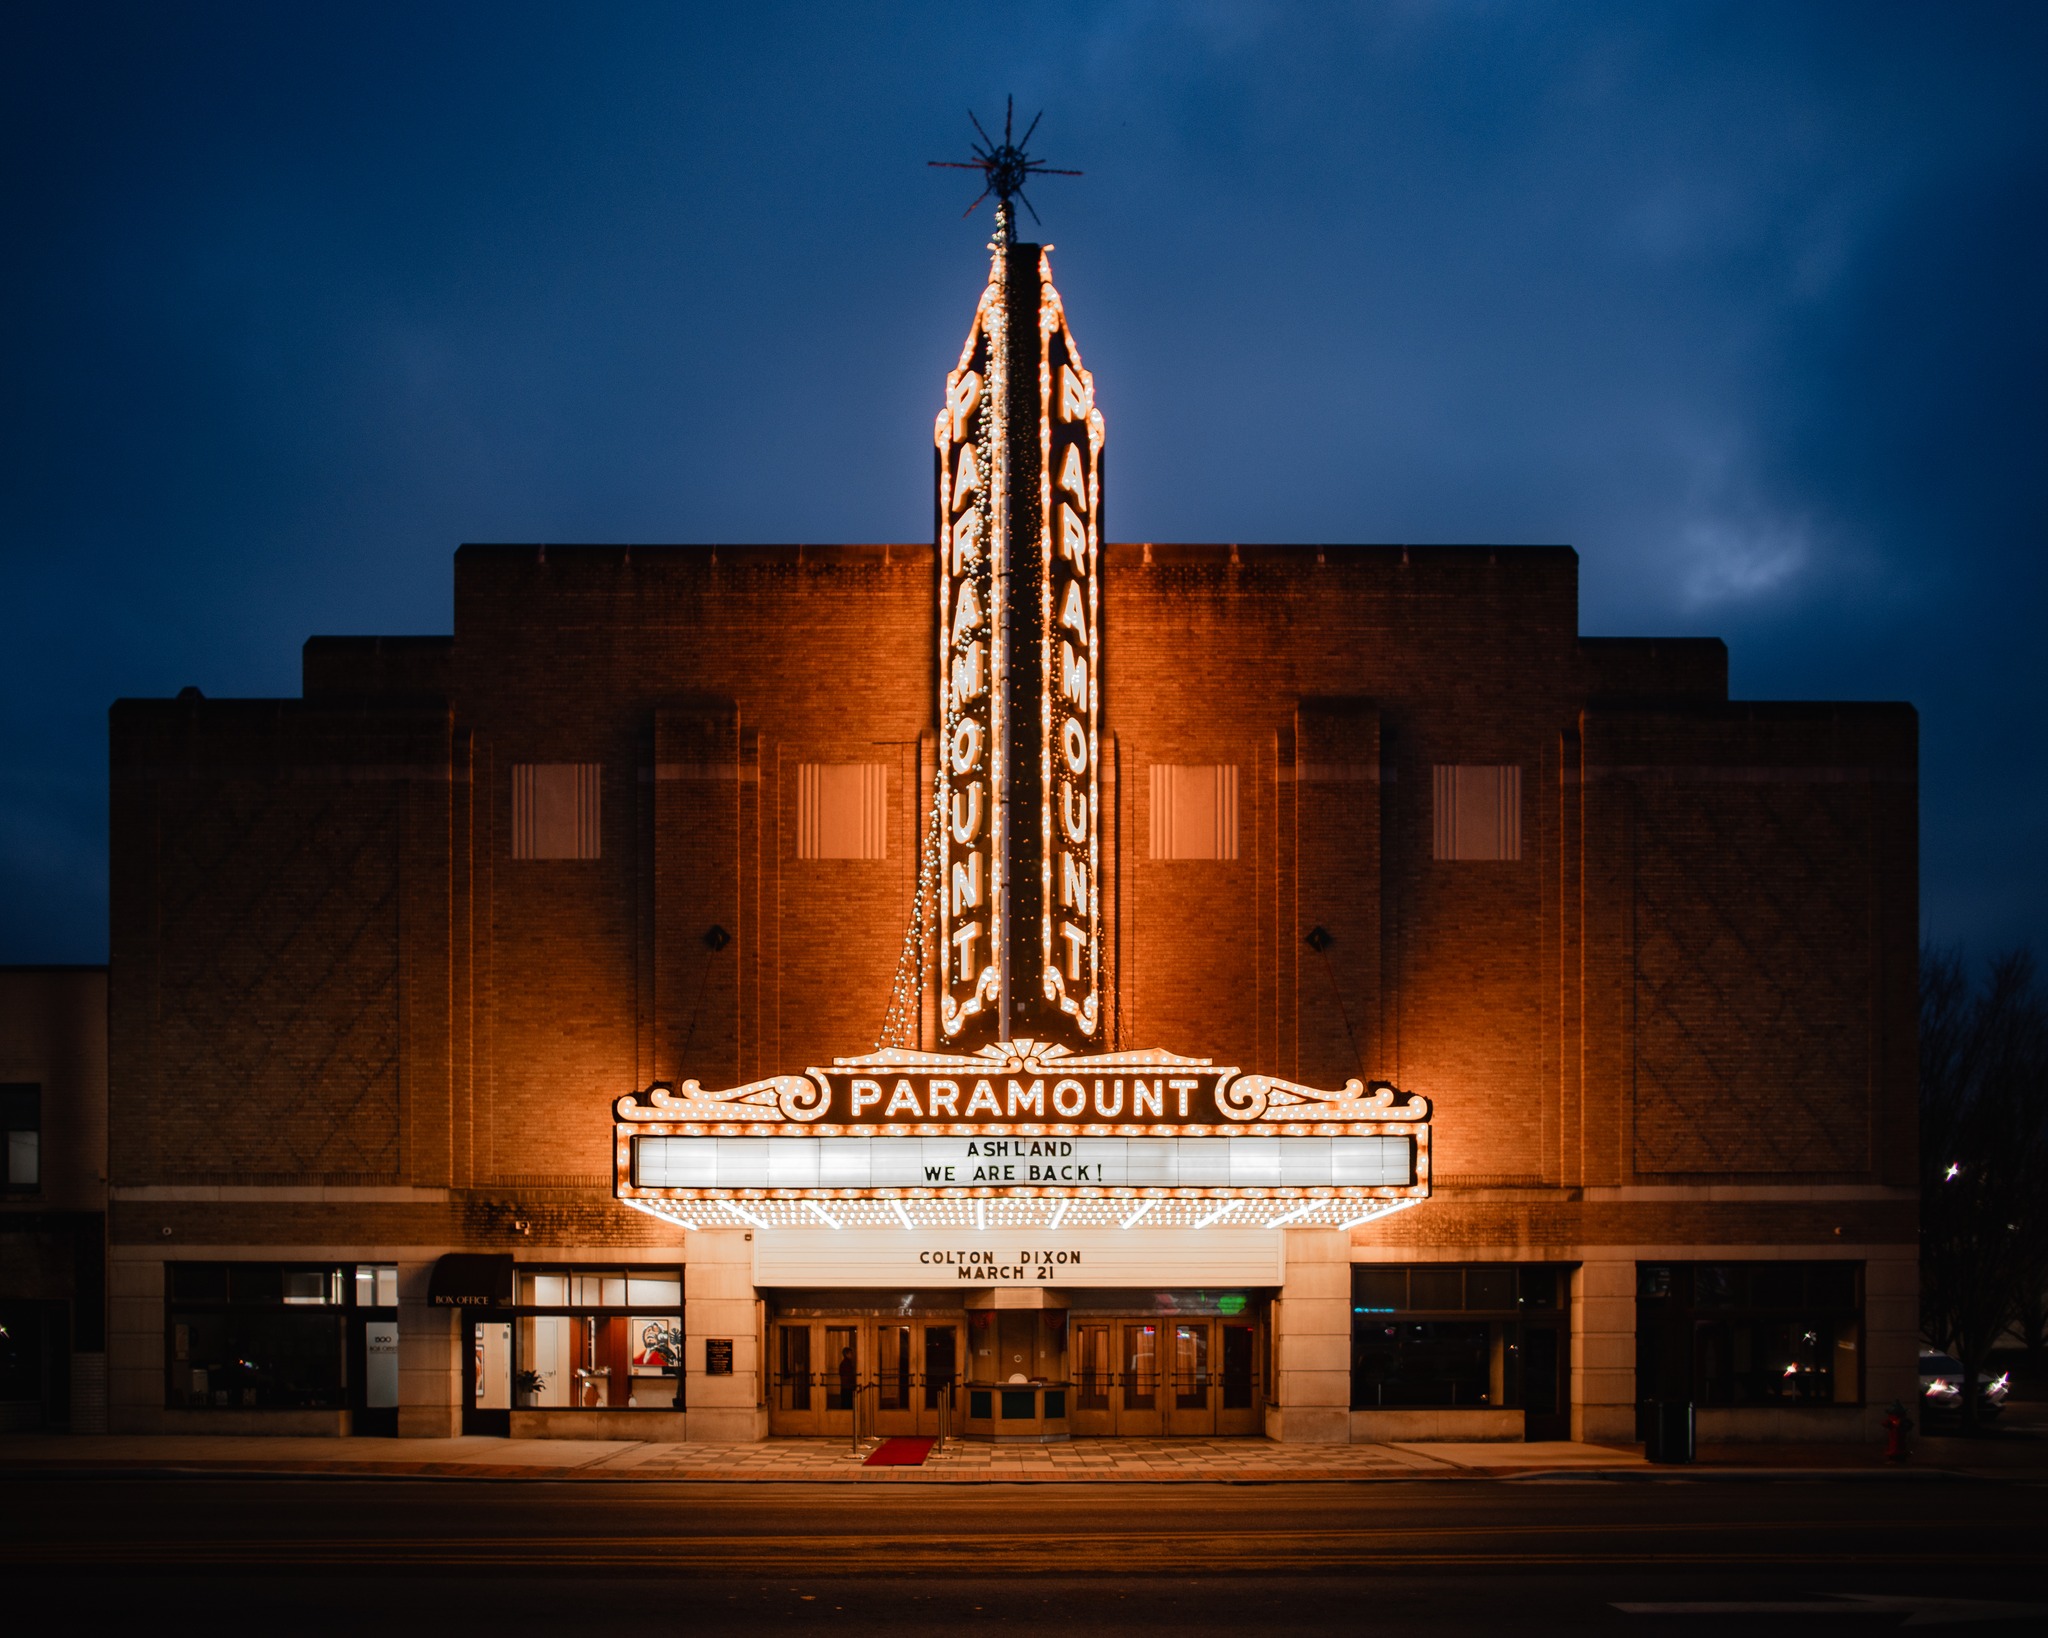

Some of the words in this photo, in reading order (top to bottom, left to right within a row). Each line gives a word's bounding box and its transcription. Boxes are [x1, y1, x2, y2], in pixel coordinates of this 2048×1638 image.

[952, 369, 984, 982] PARAMOUNT
[1057, 363, 1088, 982] PARAMOUNT
[850, 1079, 1199, 1117] PARAMOUNT
[967, 1141, 1073, 1157] ASHLAND
[924, 1166, 956, 1181] WE
[973, 1165, 1015, 1181] ARE
[1029, 1164, 1102, 1182] BACK!
[919, 1251, 994, 1264] COLTON
[1020, 1251, 1081, 1264] DIXON
[958, 1266, 1024, 1279] MARCH
[1036, 1266, 1054, 1279] 21
[435, 1295, 455, 1304] BOX
[456, 1295, 489, 1305] OFFICE
